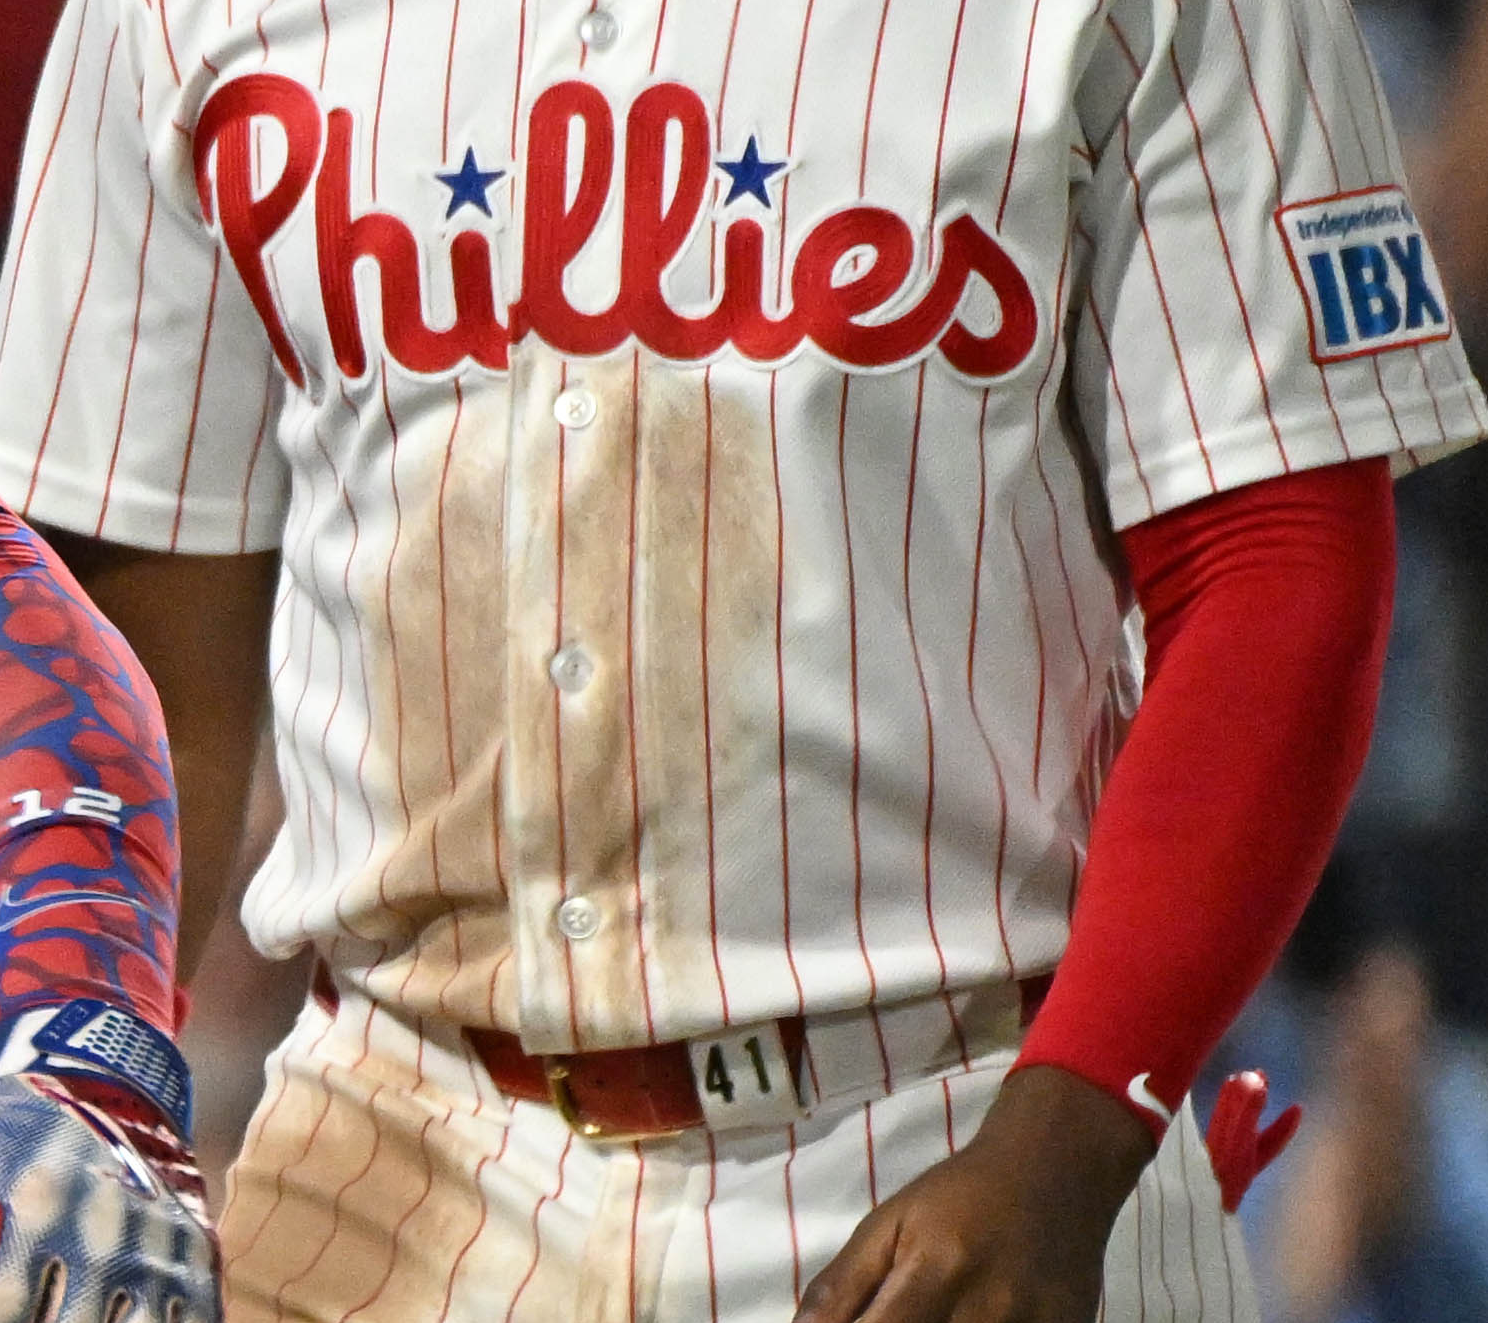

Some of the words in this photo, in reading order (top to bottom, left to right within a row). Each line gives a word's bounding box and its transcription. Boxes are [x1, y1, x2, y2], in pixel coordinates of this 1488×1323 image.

[193, 73, 1038, 390] Phillies
[1308, 232, 1445, 346] IBX
[7, 786, 122, 827] 12
[705, 1036, 772, 1104] 41
